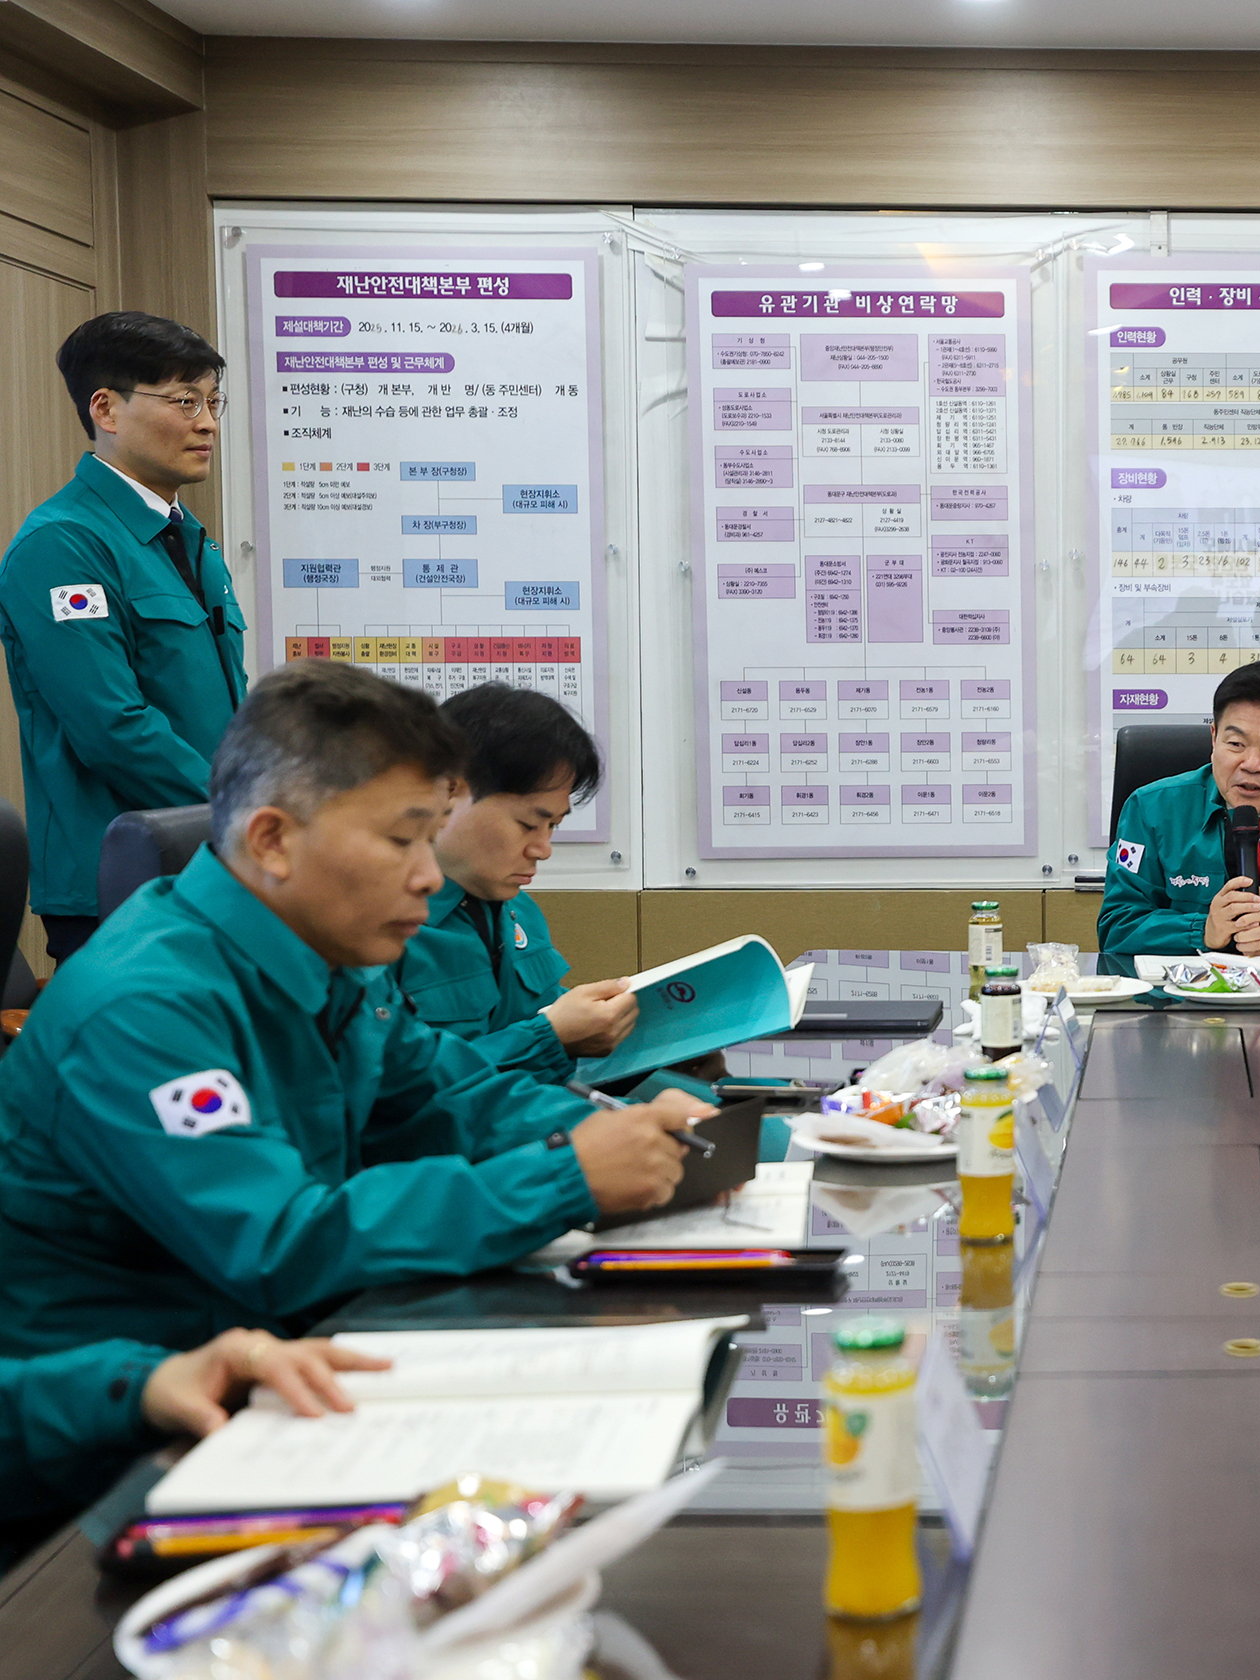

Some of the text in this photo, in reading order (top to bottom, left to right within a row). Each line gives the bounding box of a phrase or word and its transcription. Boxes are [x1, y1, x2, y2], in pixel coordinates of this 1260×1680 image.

[337, 276, 509, 295] 재난안전대책본부 편성
[1169, 288, 1201, 305] 인력
[1219, 288, 1252, 306] 장비
[759, 294, 959, 314] 유관기관 비상연락망
[283, 321, 343, 333] 제설대책기간
[501, 322, 533, 334] (4개월)
[1118, 331, 1156, 343] 인력현황
[285, 356, 444, 369] 재난안전대책본부 편성 및 근무체계
[290, 384, 330, 395] 편성현황
[341, 383, 368, 395] (구청)
[499, 384, 542, 396] 주민센터)
[342, 406, 372, 417] 재난의
[375, 406, 395, 417] 수습
[399, 406, 418, 417] 등에
[422, 406, 441, 417] 관한
[445, 406, 465, 417] 업무
[468, 406, 488, 418] 총괄
[498, 407, 517, 418] 조정
[292, 428, 331, 439] 조직체계
[300, 463, 316, 471] 1단계
[336, 463, 353, 471] 2단계
[374, 463, 390, 471] 3단계
[1119, 472, 1158, 484] 장비현황
[520, 490, 560, 499] 현장지휘소
[1118, 495, 1132, 503] 차량
[513, 500, 568, 509] (대규모 피해 시)
[301, 564, 341, 573] 지원협력관
[303, 574, 339, 583] (행정국장)
[416, 575, 465, 583] (건설안전국장)
[523, 586, 562, 595] 현장지휘소
[1119, 584, 1171, 592] 장비 및 부속장비
[515, 596, 570, 605] (대규모 피해 시)
[1120, 694, 1159, 705] 자재현황
